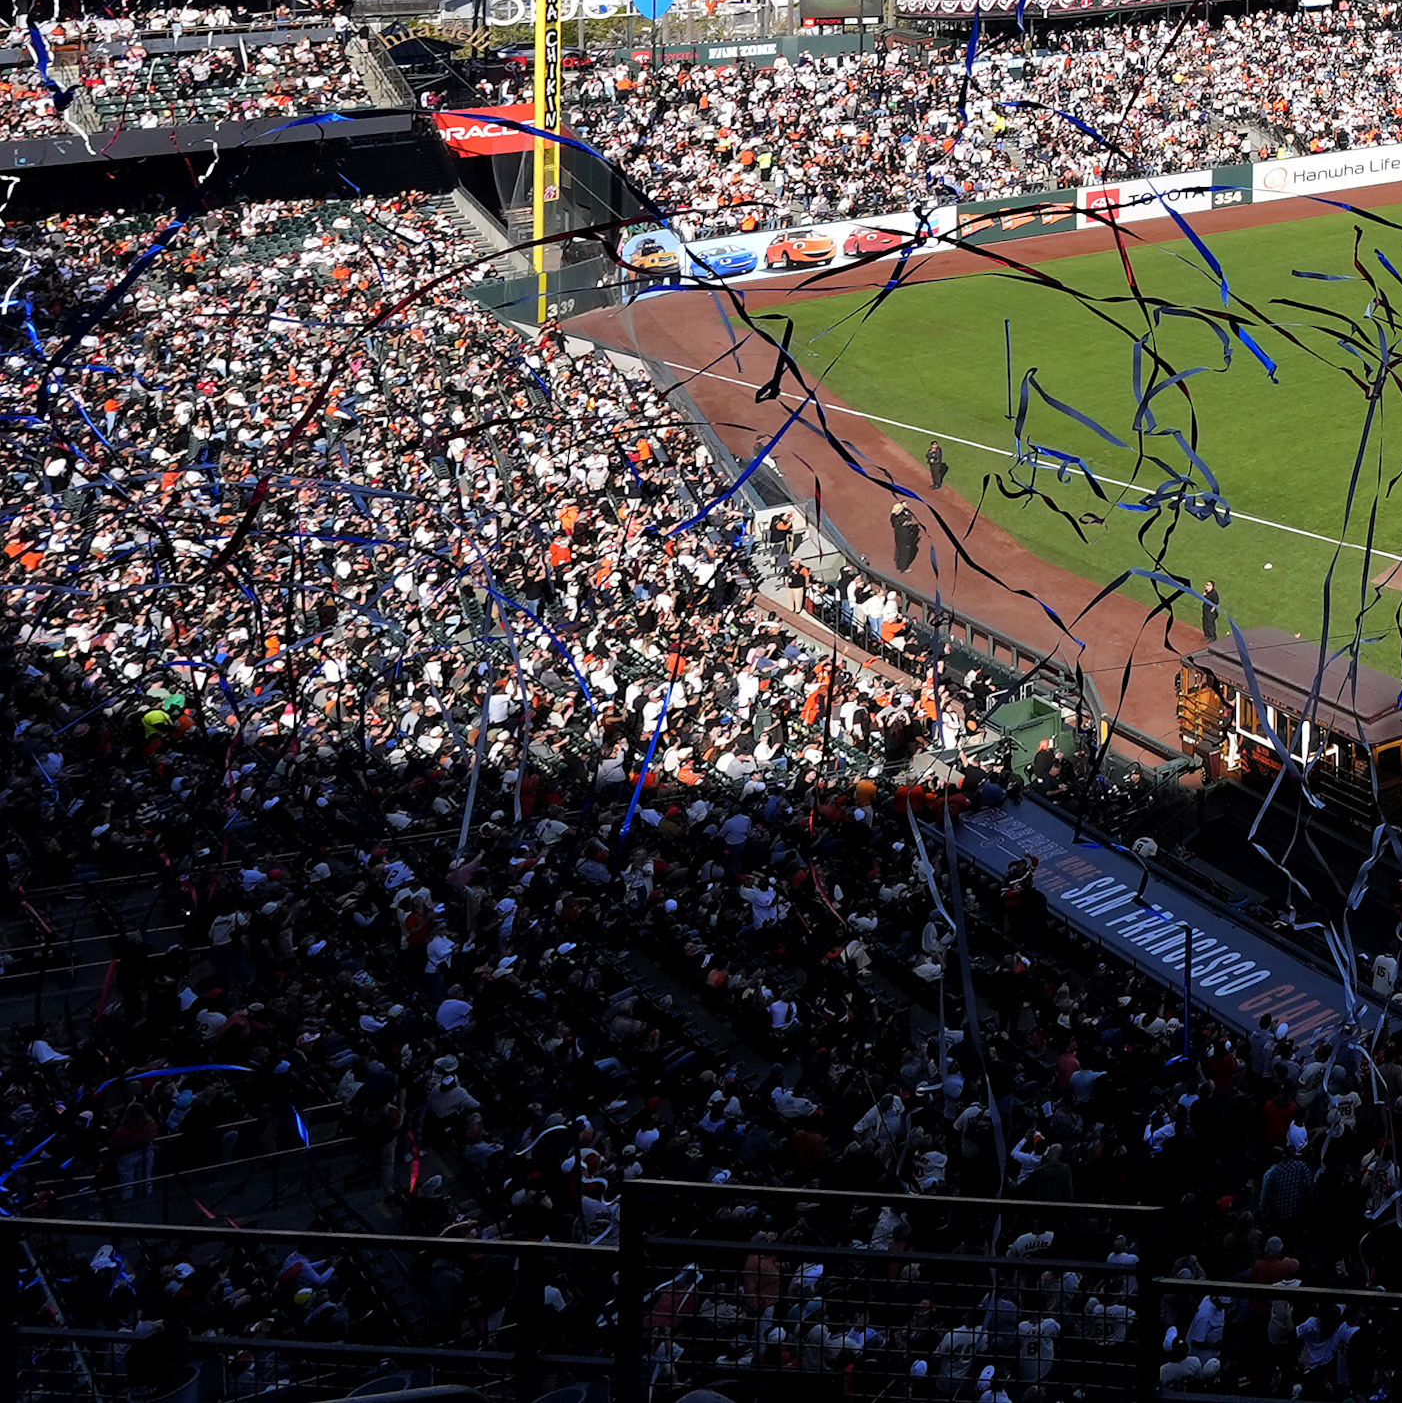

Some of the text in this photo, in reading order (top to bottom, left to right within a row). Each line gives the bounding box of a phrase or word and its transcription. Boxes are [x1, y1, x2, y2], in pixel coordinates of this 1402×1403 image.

[708, 43, 777, 60] FAN ZONE
[545, 30, 557, 129] CHIKIN
[1293, 157, 1402, 184] Hanwha Life
[1214, 191, 1242, 205] 354
[547, 298, 575, 318] 339
[1060, 876, 1139, 919] SAN
[1106, 903, 1273, 997] FRANCISCO
[1376, 965, 1387, 978] 15
